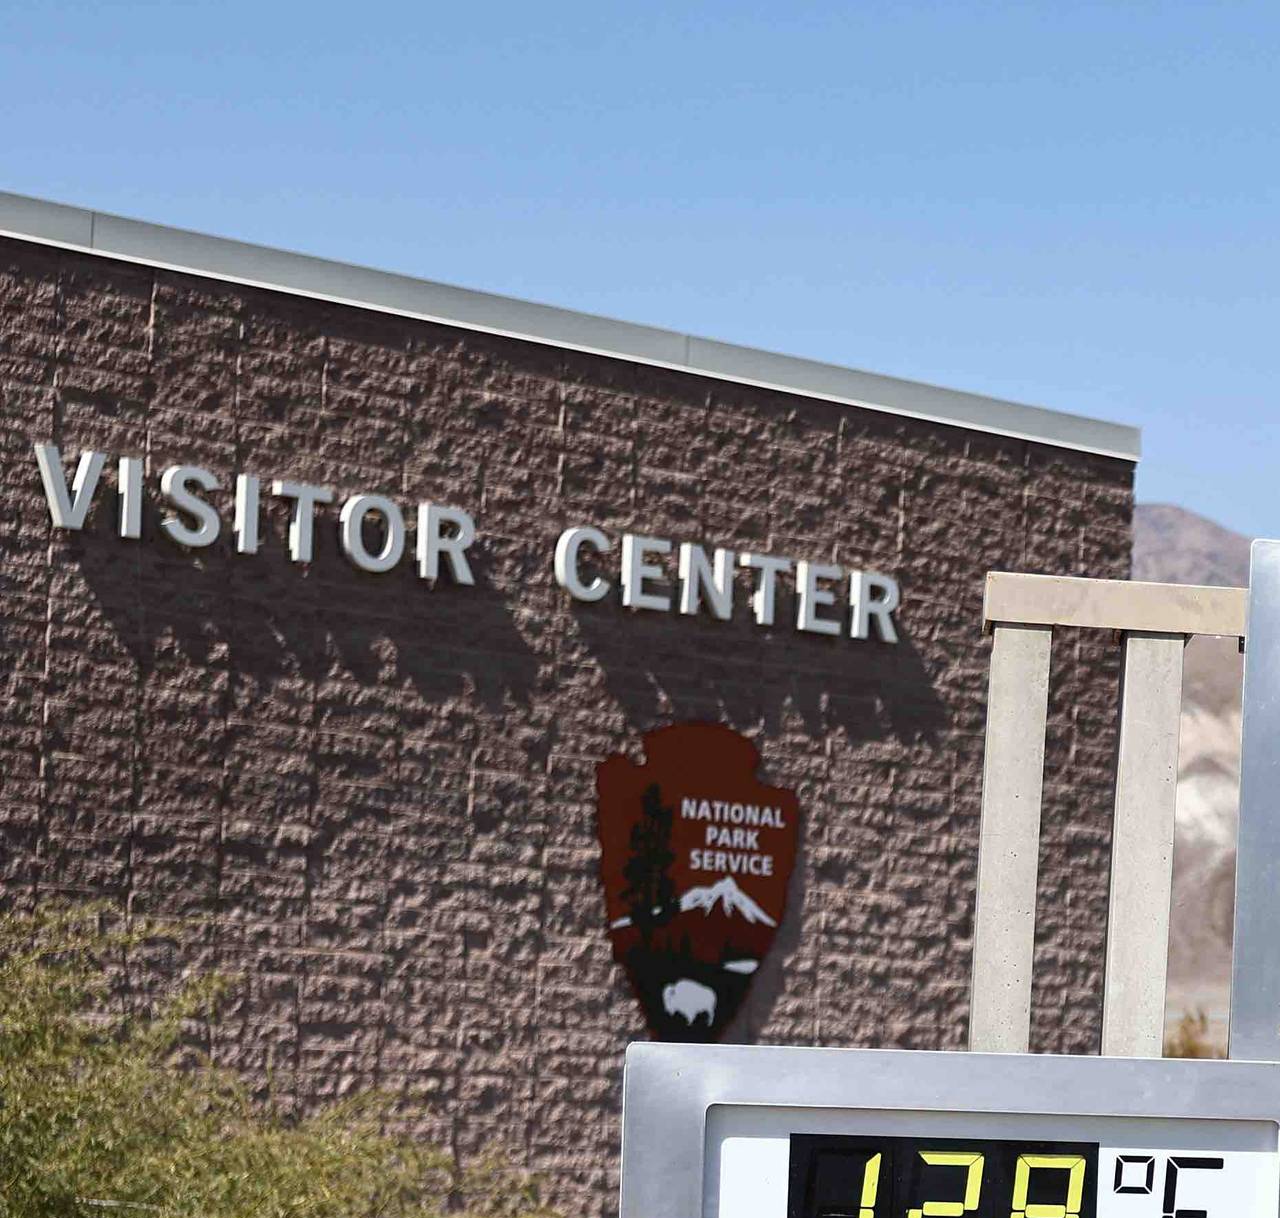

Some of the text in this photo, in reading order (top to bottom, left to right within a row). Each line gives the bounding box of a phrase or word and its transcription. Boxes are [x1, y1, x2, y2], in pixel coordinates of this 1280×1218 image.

[35, 443, 901, 644] VISITOR CENTER
[681, 796, 786, 829] NATIONAL
[706, 826, 760, 851] PARK
[690, 850, 773, 877] SERVICE
